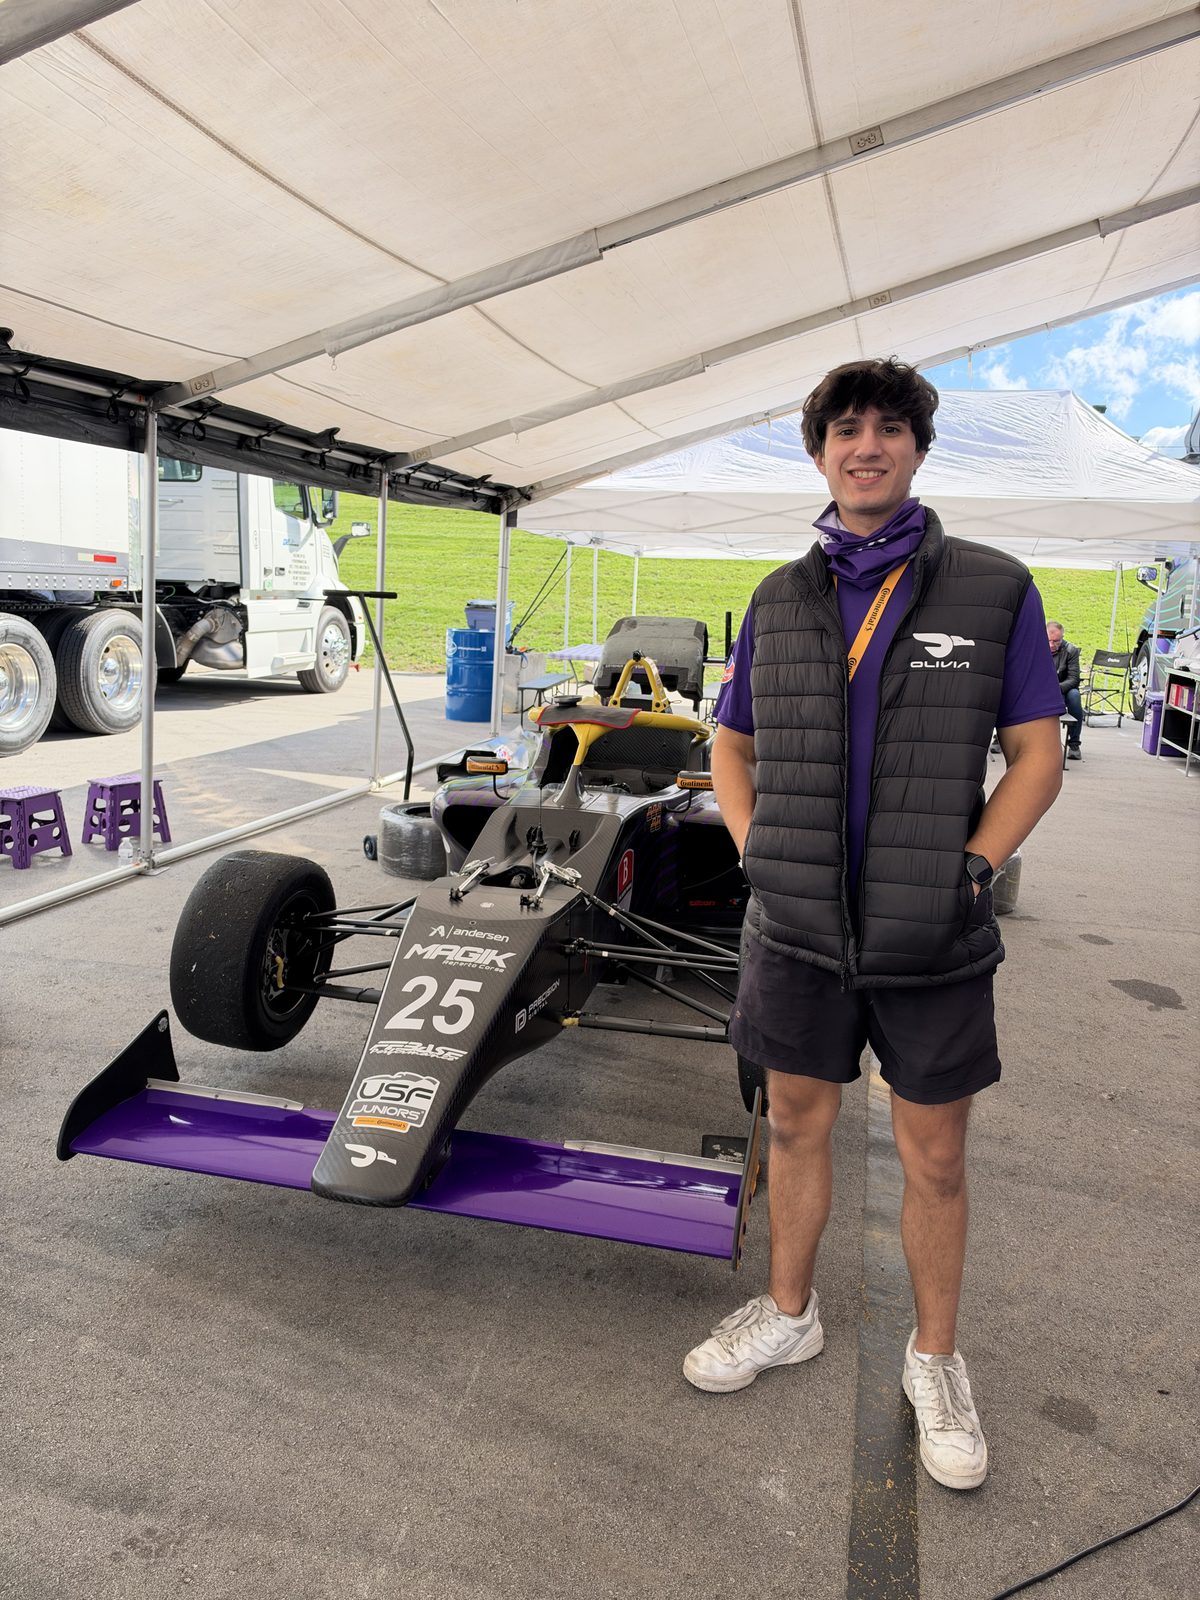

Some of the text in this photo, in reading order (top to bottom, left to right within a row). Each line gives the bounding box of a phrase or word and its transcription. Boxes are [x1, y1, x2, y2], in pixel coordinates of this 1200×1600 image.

[867, 587, 891, 628] Continental
[910, 660, 970, 669] OLIVIA
[680, 779, 714, 787] Continenta
[453, 928, 510, 943] andersen
[403, 943, 517, 969] MAGIK
[441, 959, 505, 973] Reparto Corse
[383, 975, 484, 1035] 25
[528, 978, 560, 1014] PRECISION
[359, 1082, 434, 1104] USF
[352, 1104, 421, 1120] JUNIORS
